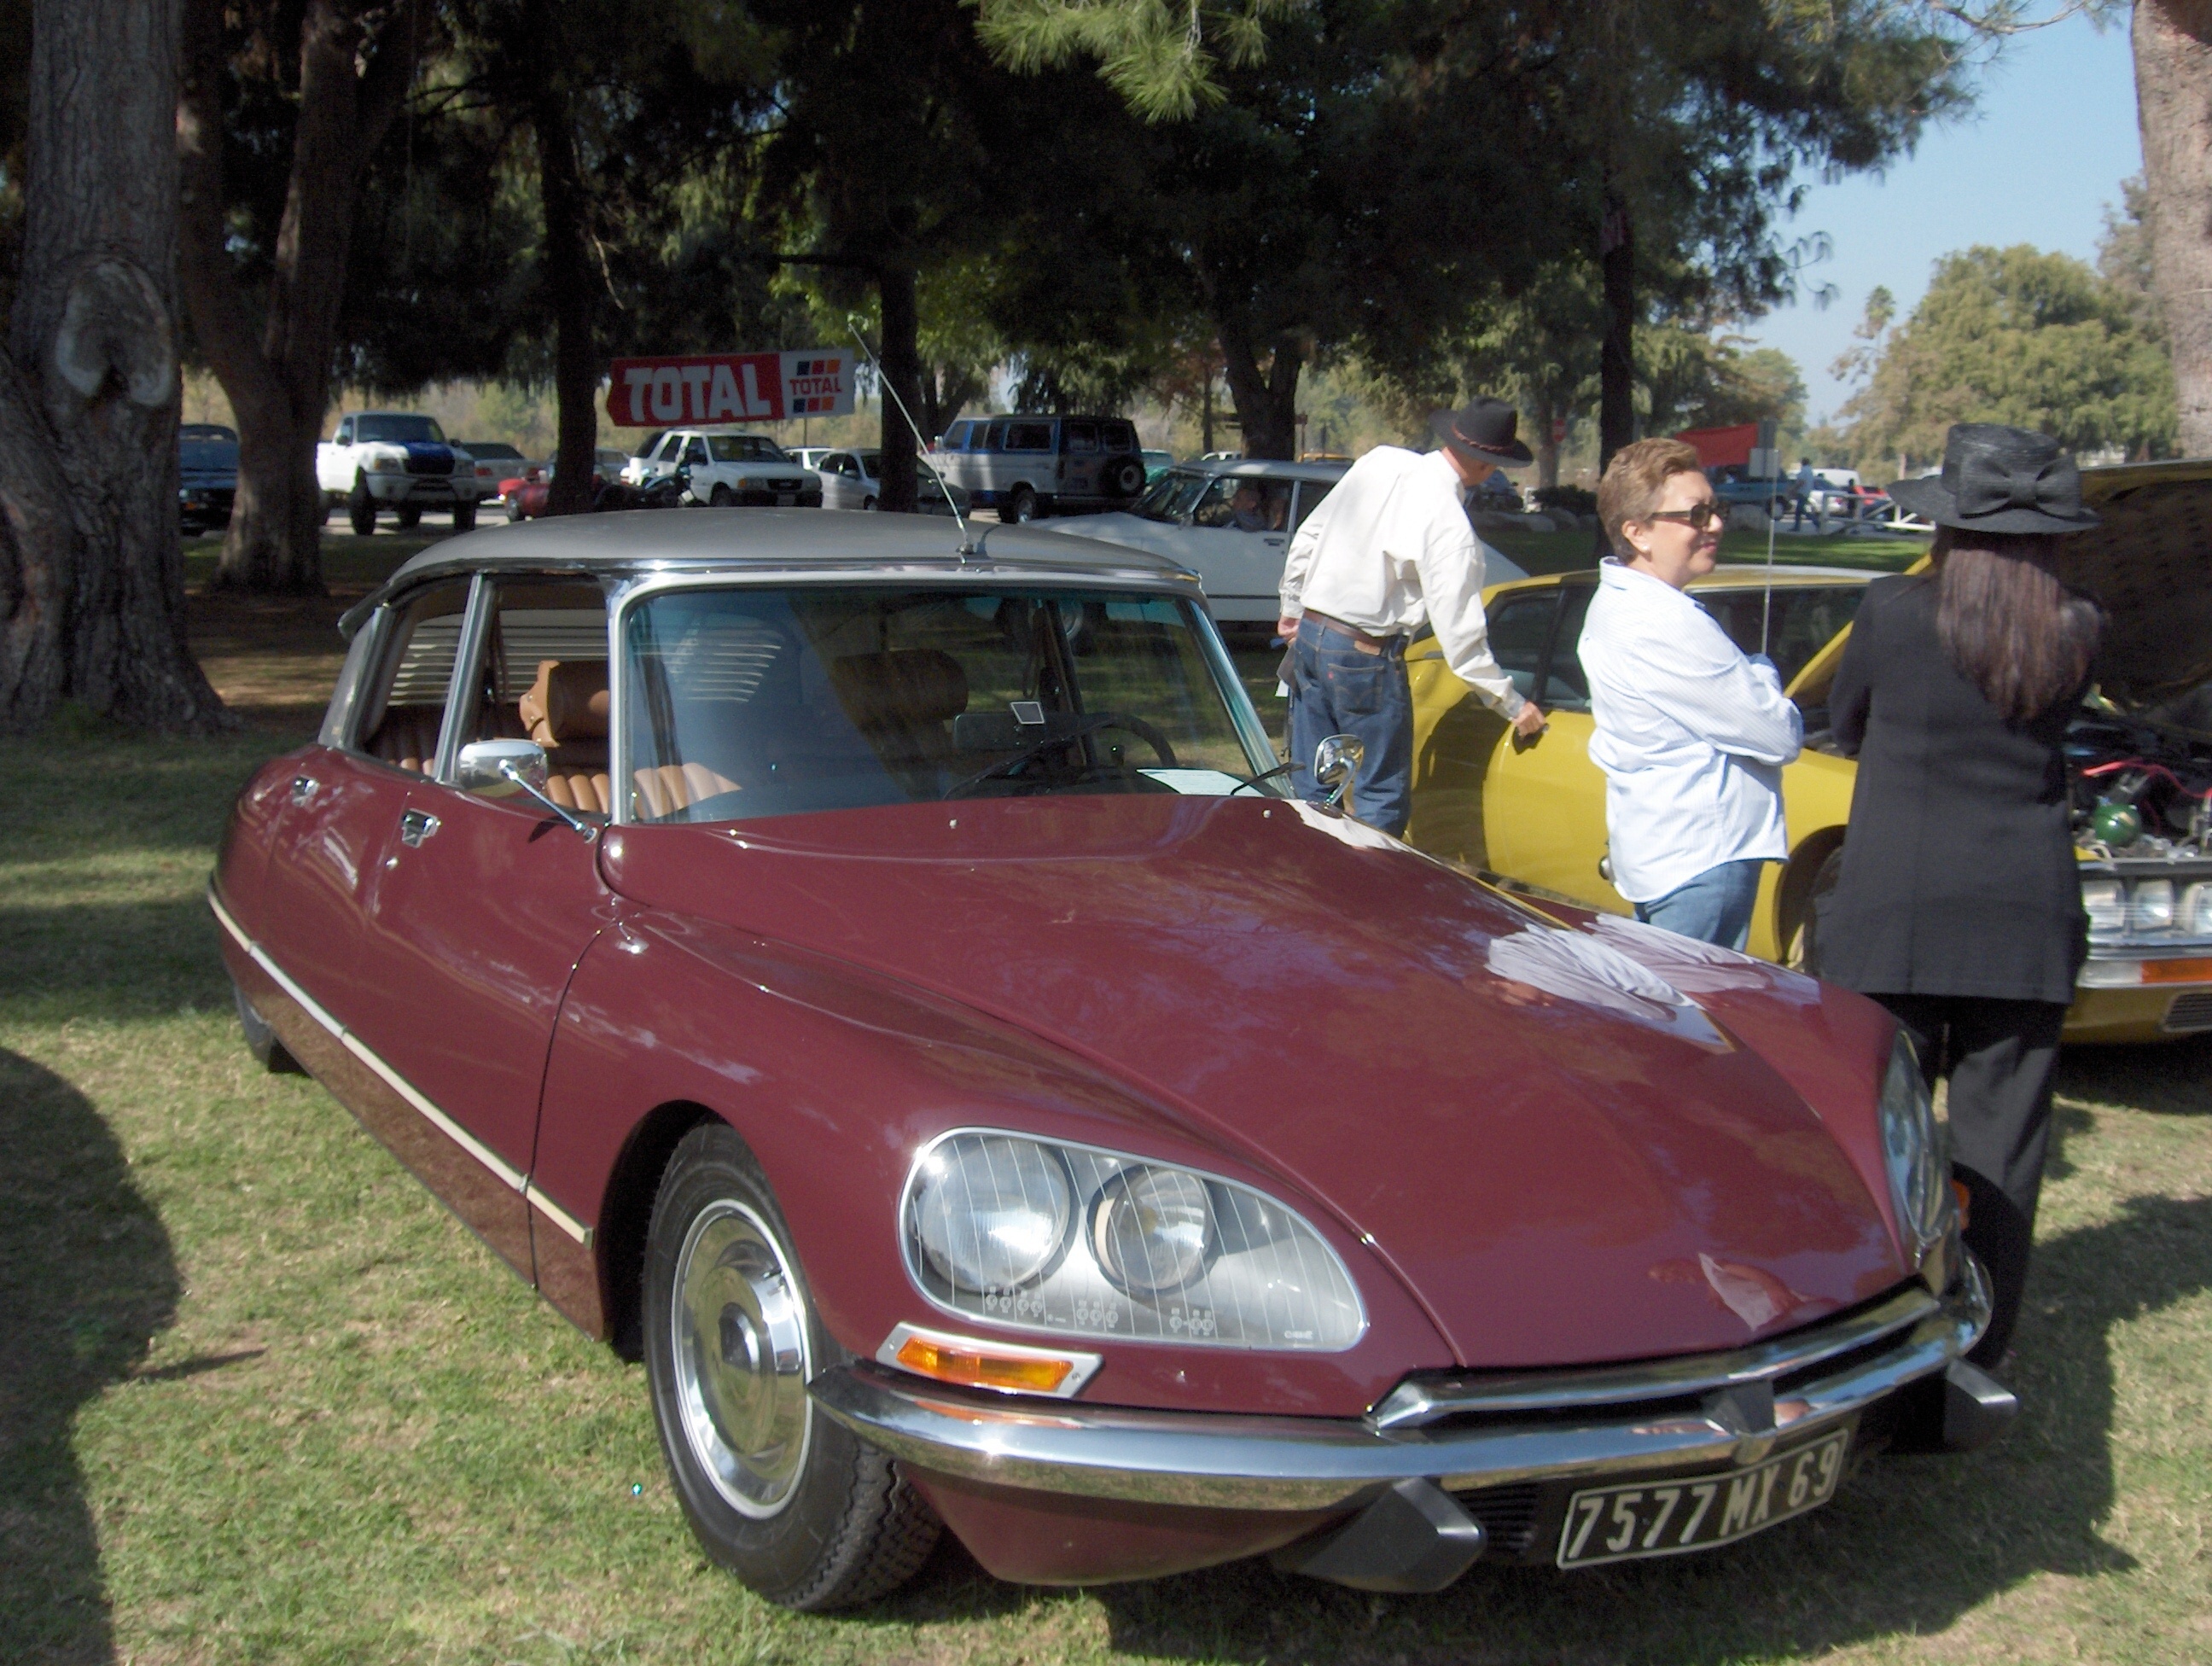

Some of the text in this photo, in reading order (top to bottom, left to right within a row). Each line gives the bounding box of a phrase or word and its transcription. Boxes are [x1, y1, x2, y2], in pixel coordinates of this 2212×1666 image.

[624, 363, 772, 422] TOTAL
[789, 376, 842, 396] TOTAL
[1567, 1441, 1839, 1559] 7577 MX 69
